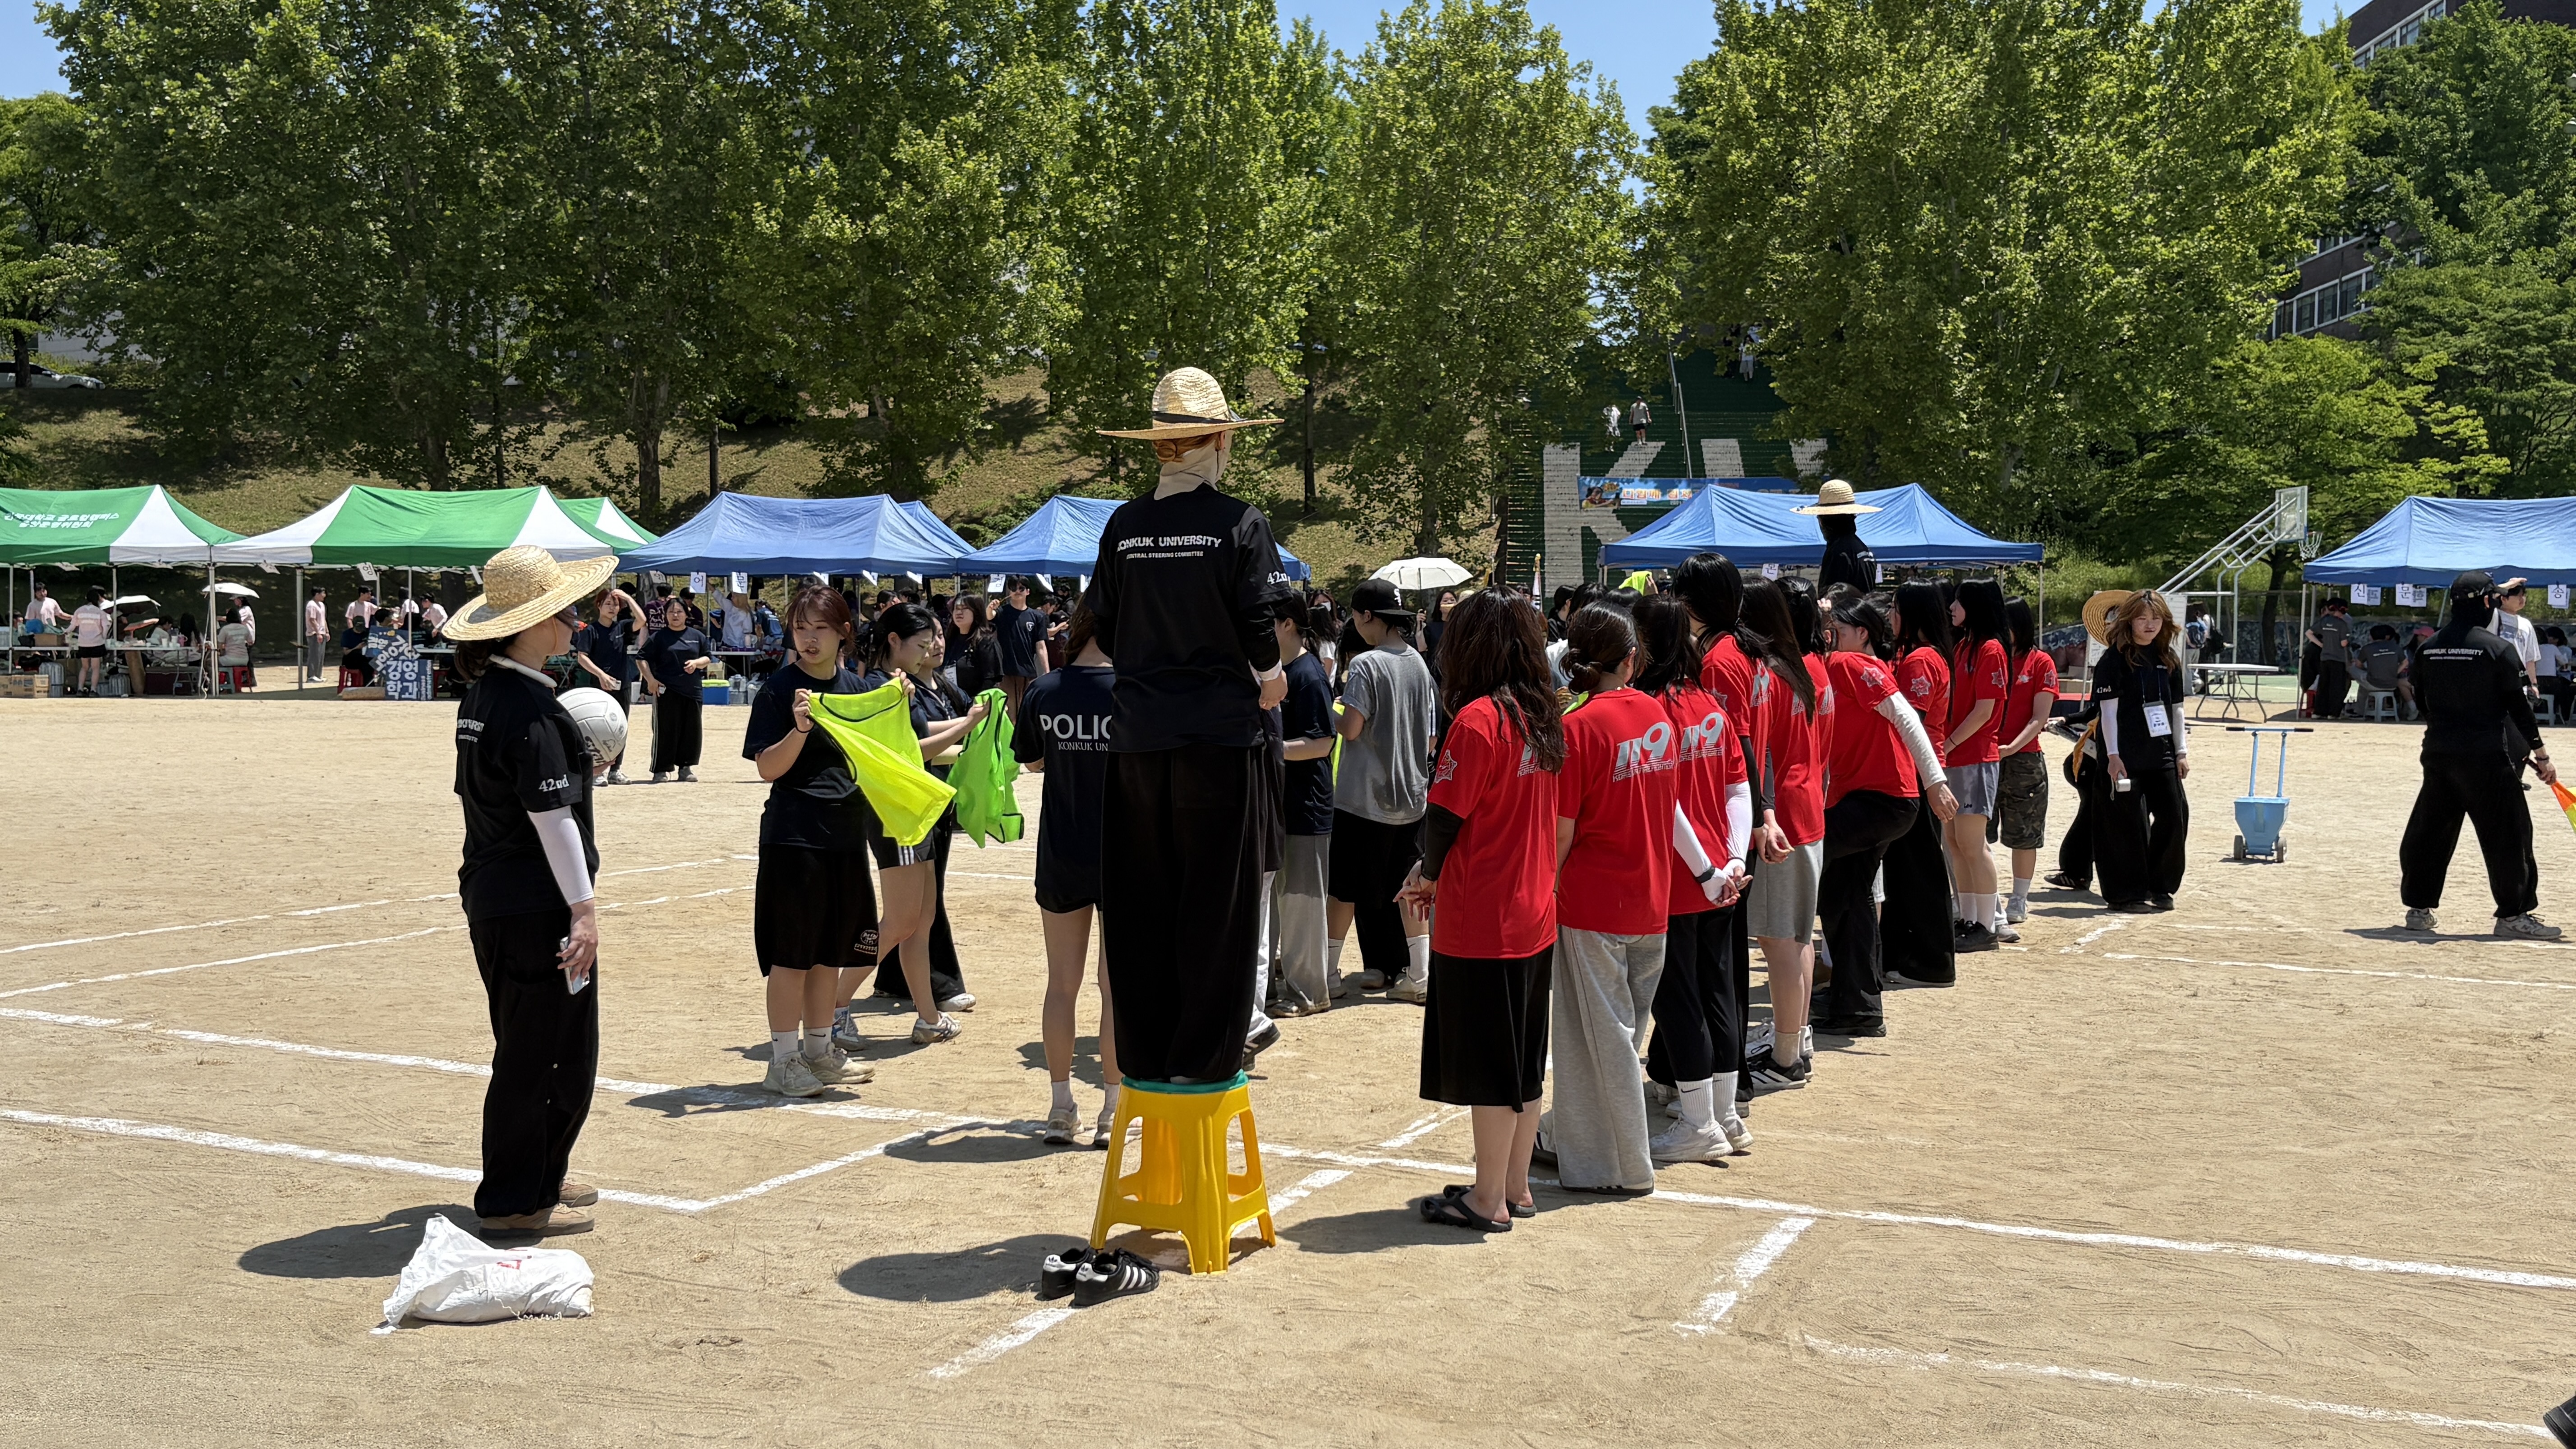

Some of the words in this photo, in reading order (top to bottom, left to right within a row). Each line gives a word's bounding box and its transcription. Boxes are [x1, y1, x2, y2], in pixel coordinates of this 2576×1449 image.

[1158, 535, 1222, 547] UNIVERSITY
[2354, 584, 2365, 598] 신
[2399, 586, 2411, 599] 문
[2552, 586, 2564, 598] 송
[386, 660, 419, 681] 경영
[386, 680, 419, 699] 학과
[1680, 713, 1724, 758] 119
[1058, 741, 1093, 751] KONKUK
[1615, 722, 1670, 773] 119
[538, 774, 569, 792] 42nd
